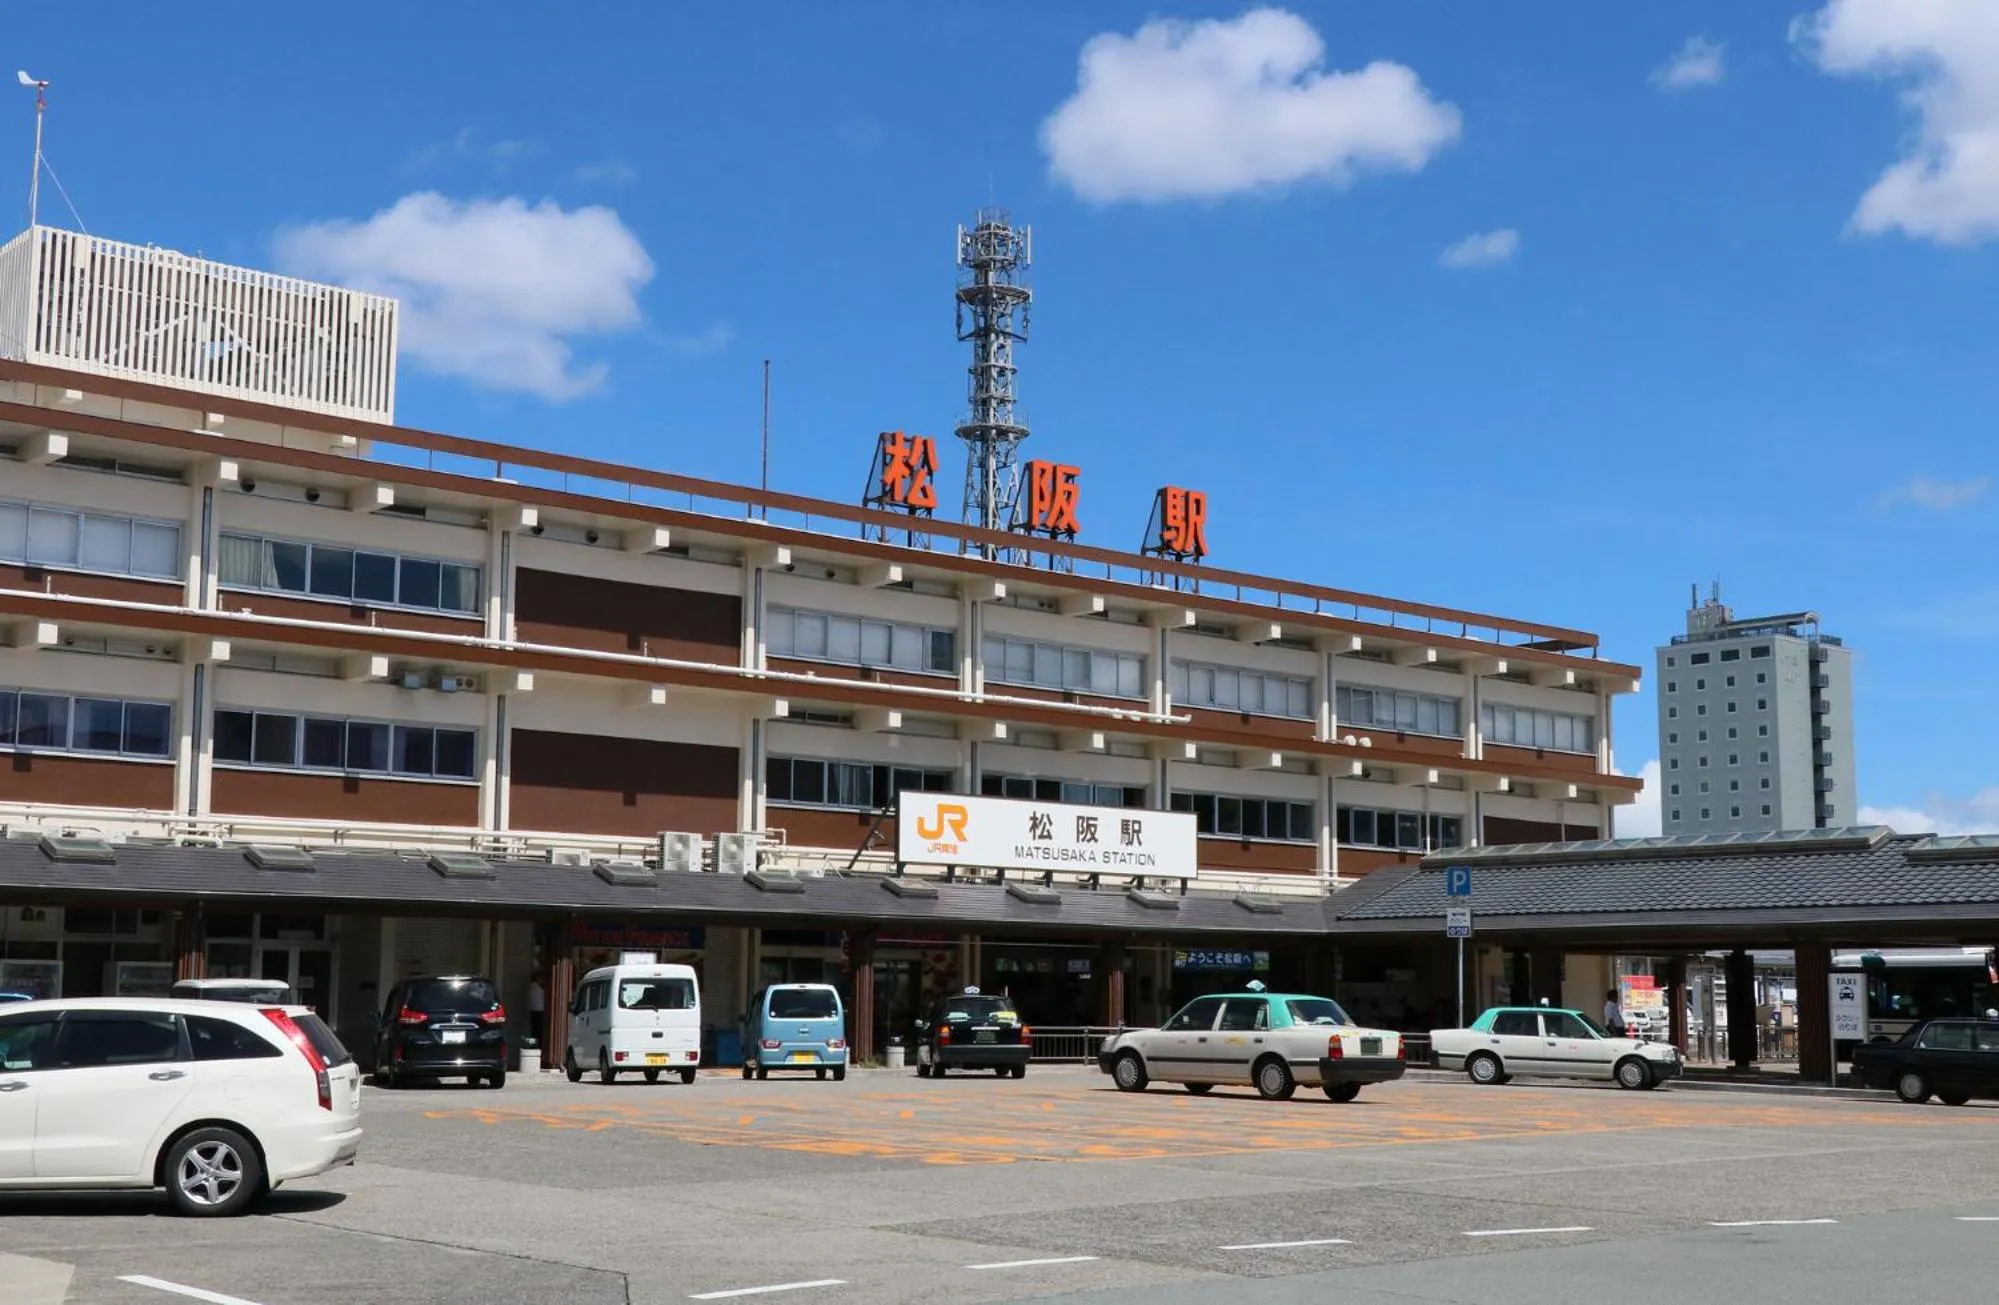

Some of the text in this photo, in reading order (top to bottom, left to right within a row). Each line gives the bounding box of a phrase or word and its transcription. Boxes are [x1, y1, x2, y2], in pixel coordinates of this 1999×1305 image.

[917, 803, 968, 842] JR
[1029, 811, 1143, 847] 松阪駅
[1014, 845, 1156, 866] MATSUSAKA STATION
[1452, 870, 1467, 893] P
[1836, 978, 1857, 986] TAXI
